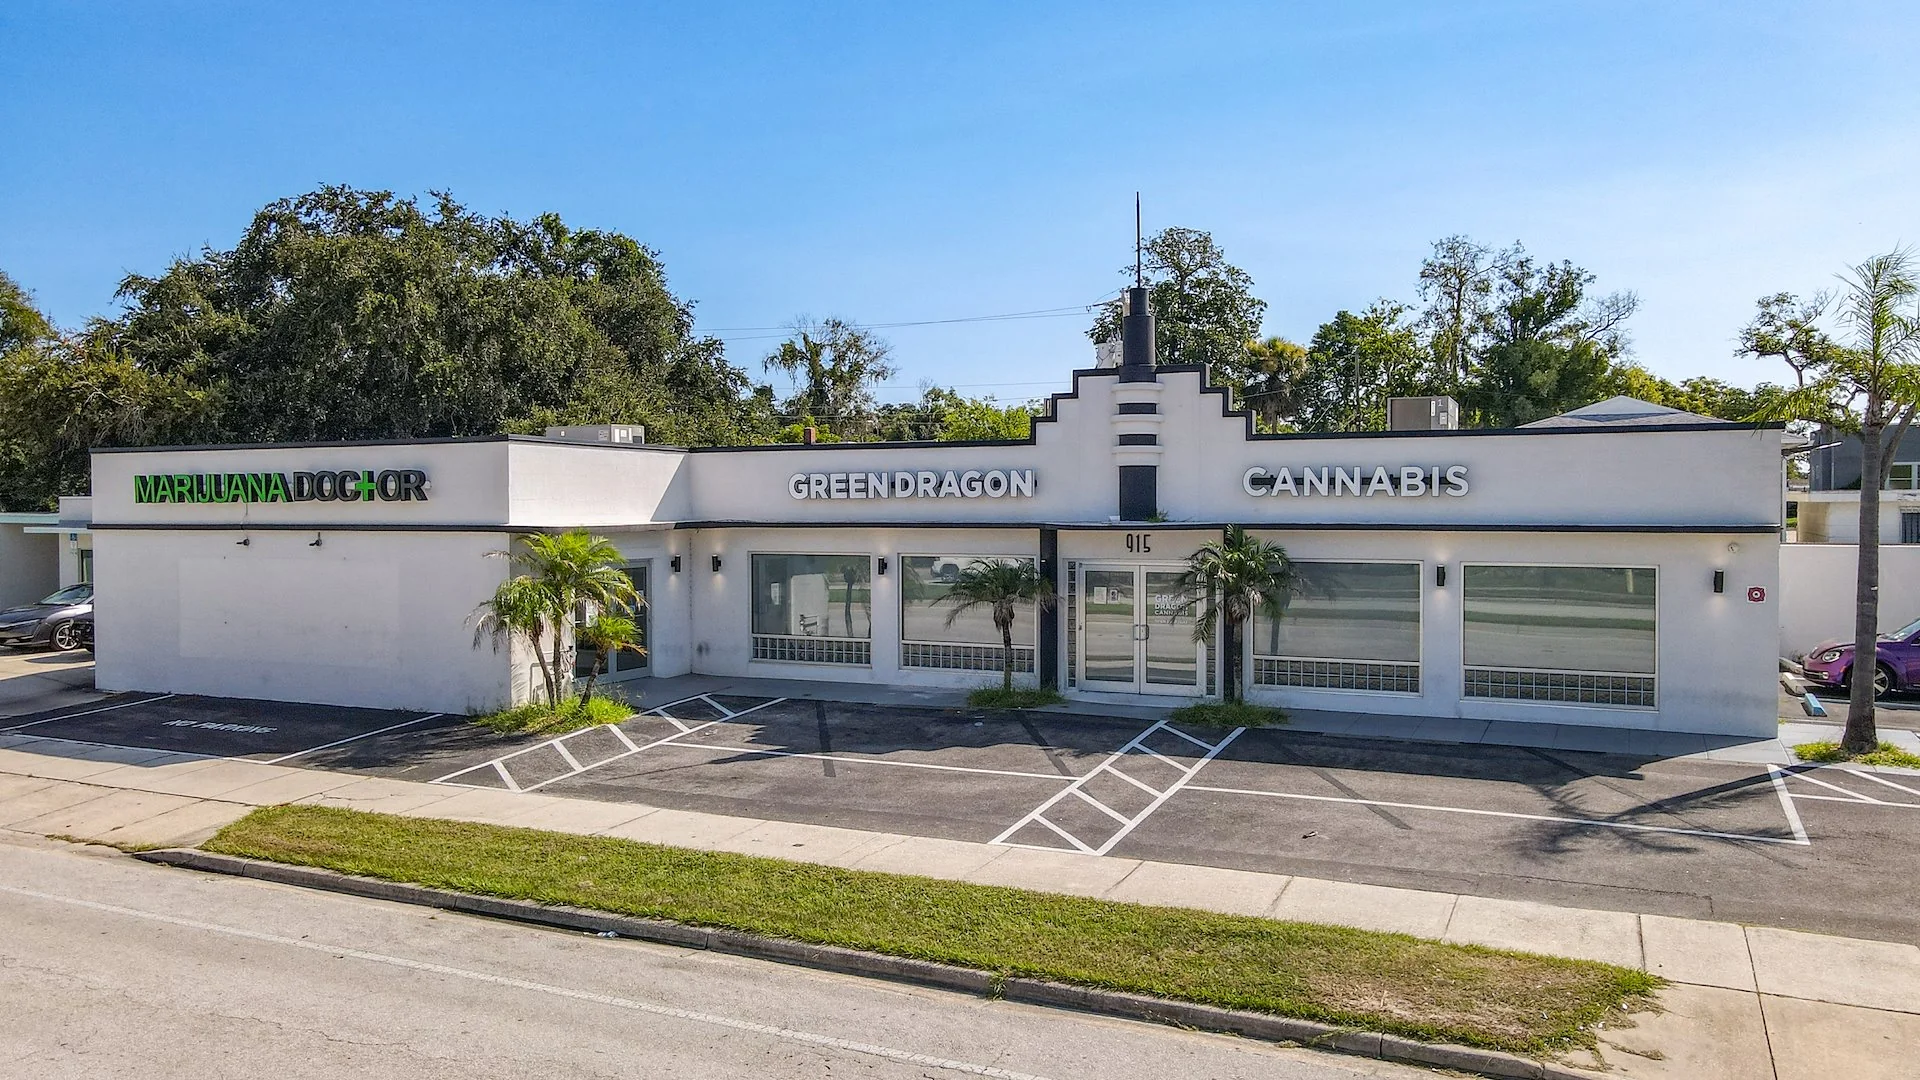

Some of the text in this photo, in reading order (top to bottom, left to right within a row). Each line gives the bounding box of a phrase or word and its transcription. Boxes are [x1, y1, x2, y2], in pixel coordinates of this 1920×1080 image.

[134, 469, 428, 504] MARIJUANA DOCTOR
[788, 469, 1034, 500] GREEN DRAGON
[1242, 465, 1470, 497] CANNABIS
[1126, 533, 1151, 553] 915
[162, 719, 278, 733] NO PARKING
